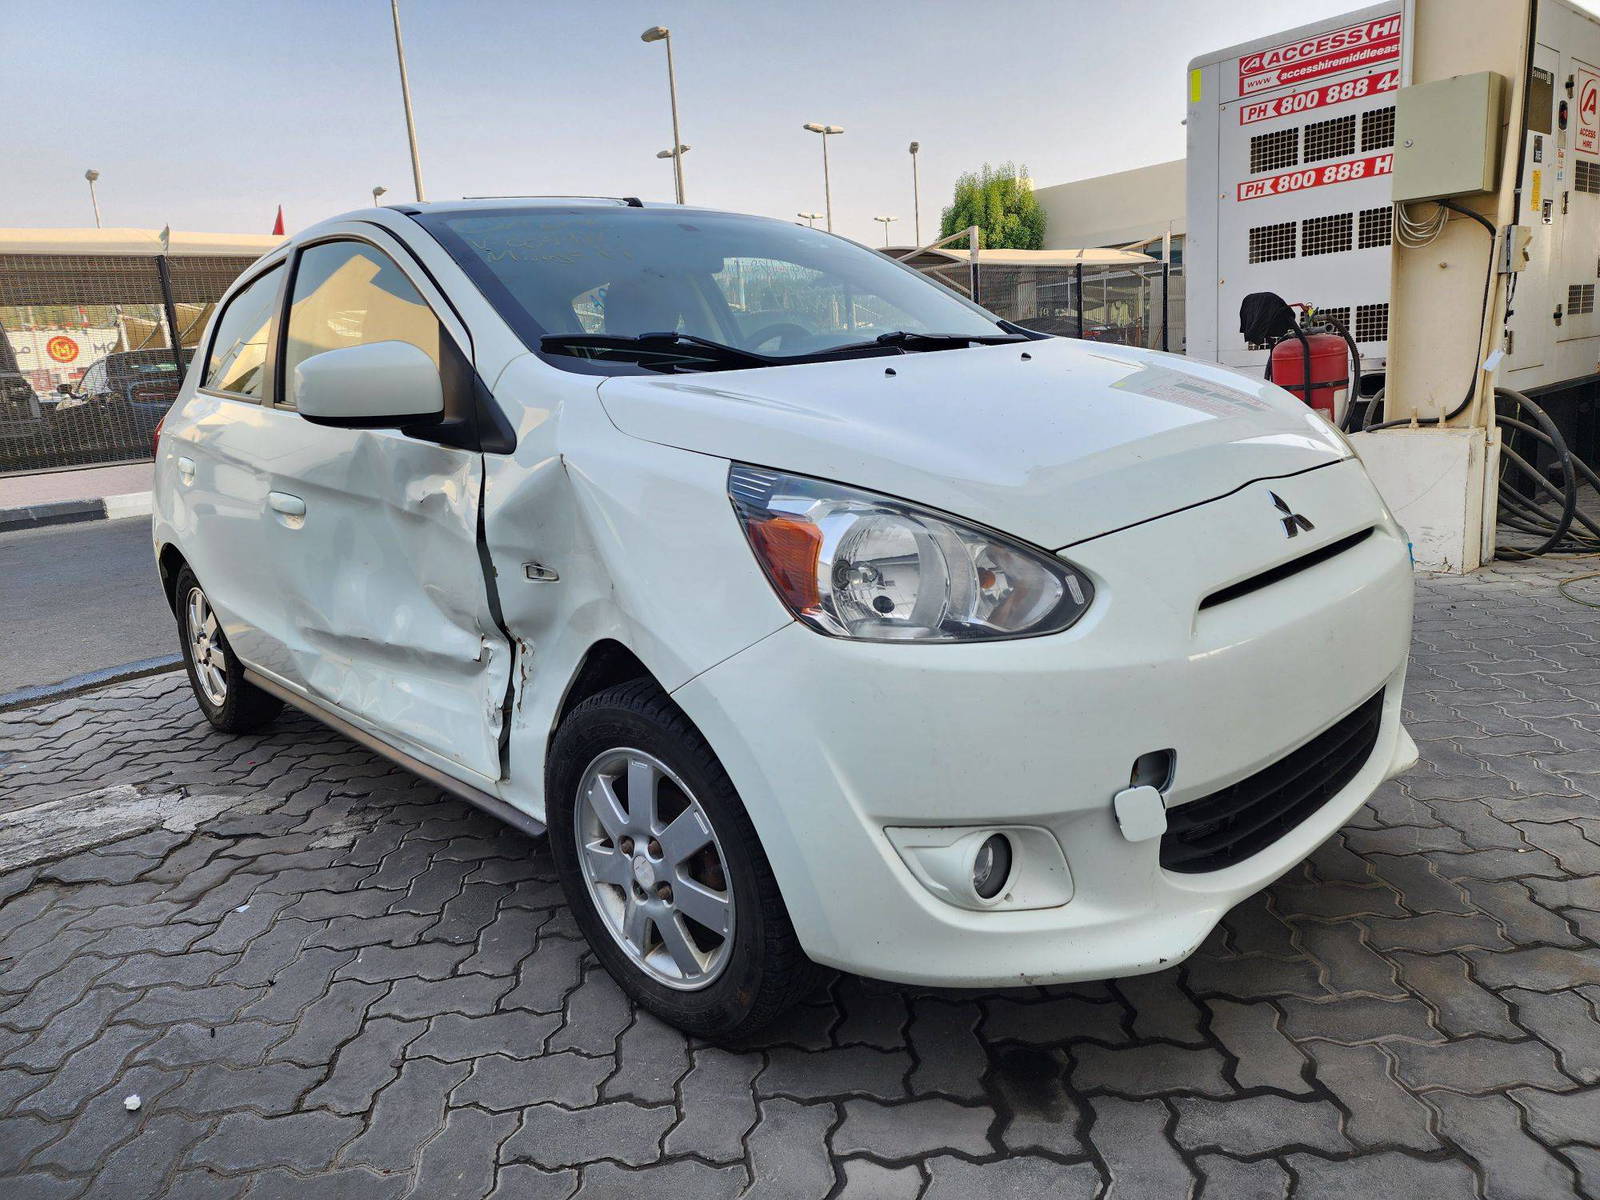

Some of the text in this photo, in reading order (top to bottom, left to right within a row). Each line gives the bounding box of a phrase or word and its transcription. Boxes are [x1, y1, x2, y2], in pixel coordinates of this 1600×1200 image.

[1267, 27, 1364, 66] ACCESS
[1370, 18, 1400, 39] HI
[1247, 76, 1272, 88] www
[1248, 104, 1268, 120] PH
[1280, 90, 1319, 114] 800
[1326, 78, 1369, 103] 888
[1580, 128, 1596, 139] ACCESS
[1583, 140, 1592, 149] HIRE
[1245, 181, 1265, 197] PH
[1277, 170, 1316, 192] 800
[1322, 161, 1365, 183] 888
